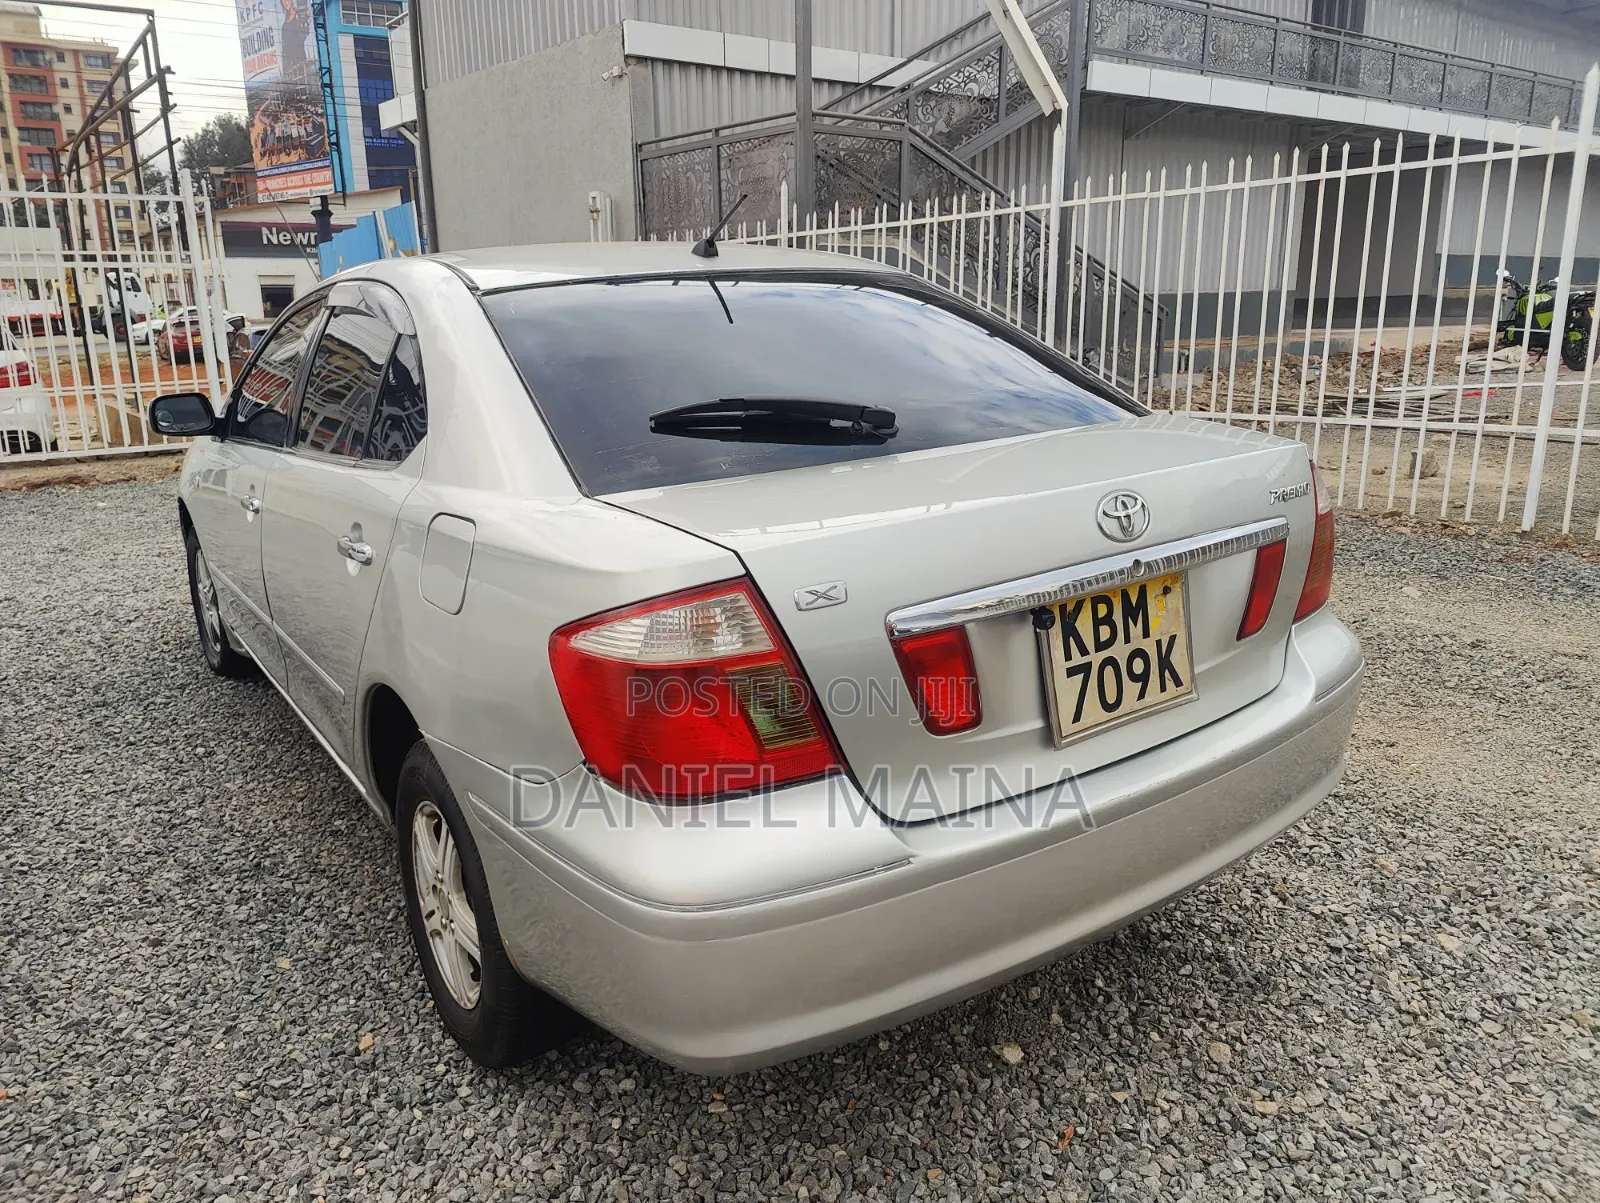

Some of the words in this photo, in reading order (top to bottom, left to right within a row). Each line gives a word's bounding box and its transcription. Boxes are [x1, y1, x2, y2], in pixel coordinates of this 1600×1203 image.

[242, 26, 275, 58] BUILDING
[1269, 481, 1311, 505] PREMIO
[1058, 583, 1151, 663] KBM
[1065, 633, 1184, 725] 709K
